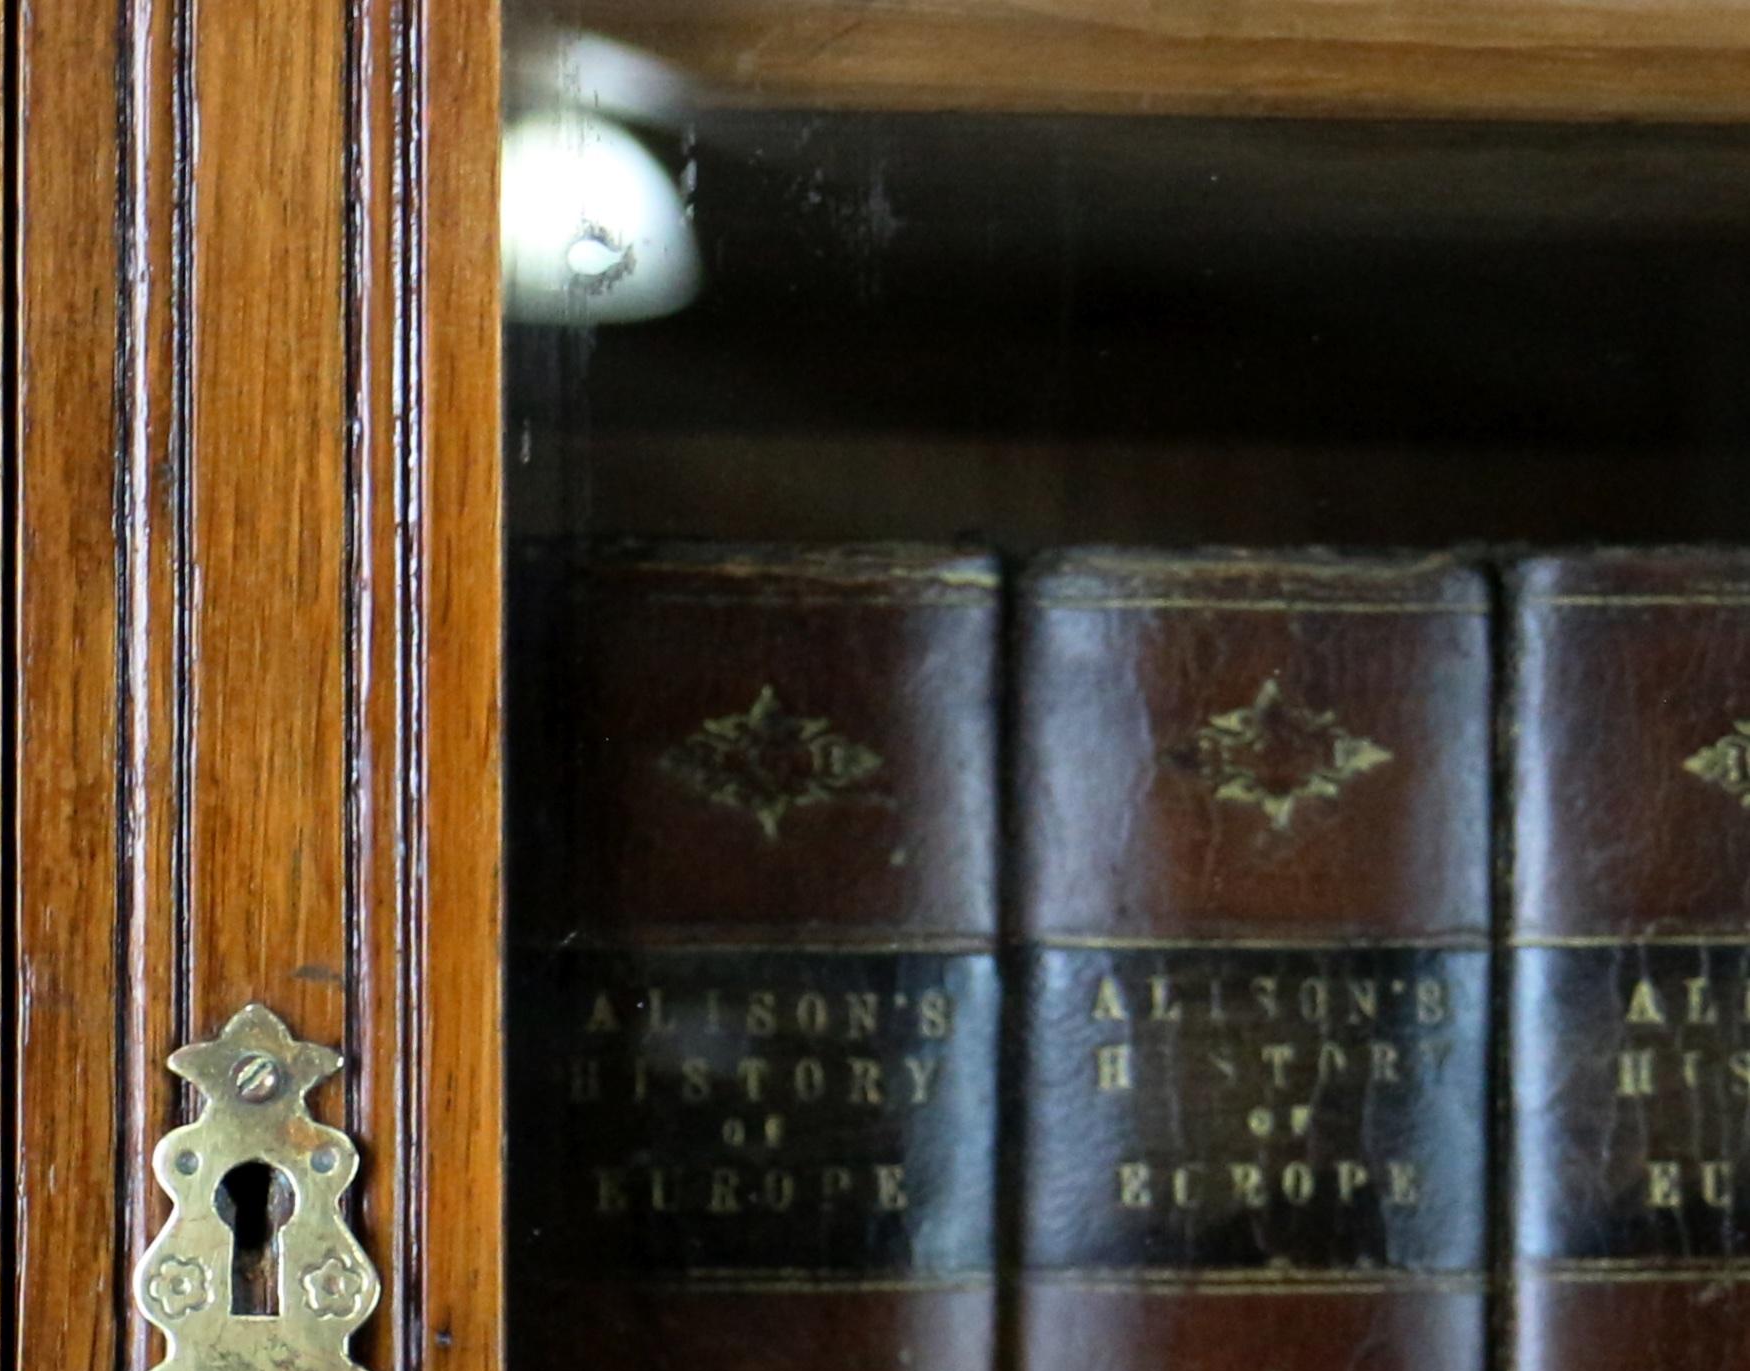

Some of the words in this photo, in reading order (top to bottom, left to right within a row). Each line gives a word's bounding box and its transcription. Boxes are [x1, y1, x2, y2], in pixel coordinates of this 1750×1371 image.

[585, 985, 953, 1041] ALISON'S
[1090, 973, 1450, 1027] ALISON'S
[569, 1054, 940, 1106] HISTORY
[1095, 1040, 1453, 1092] HSTORY
[720, 1111, 787, 1150] OF
[1246, 1103, 1315, 1138] OF
[595, 1160, 911, 1216] EUROPE
[1118, 1159, 1422, 1210] EUROPE
